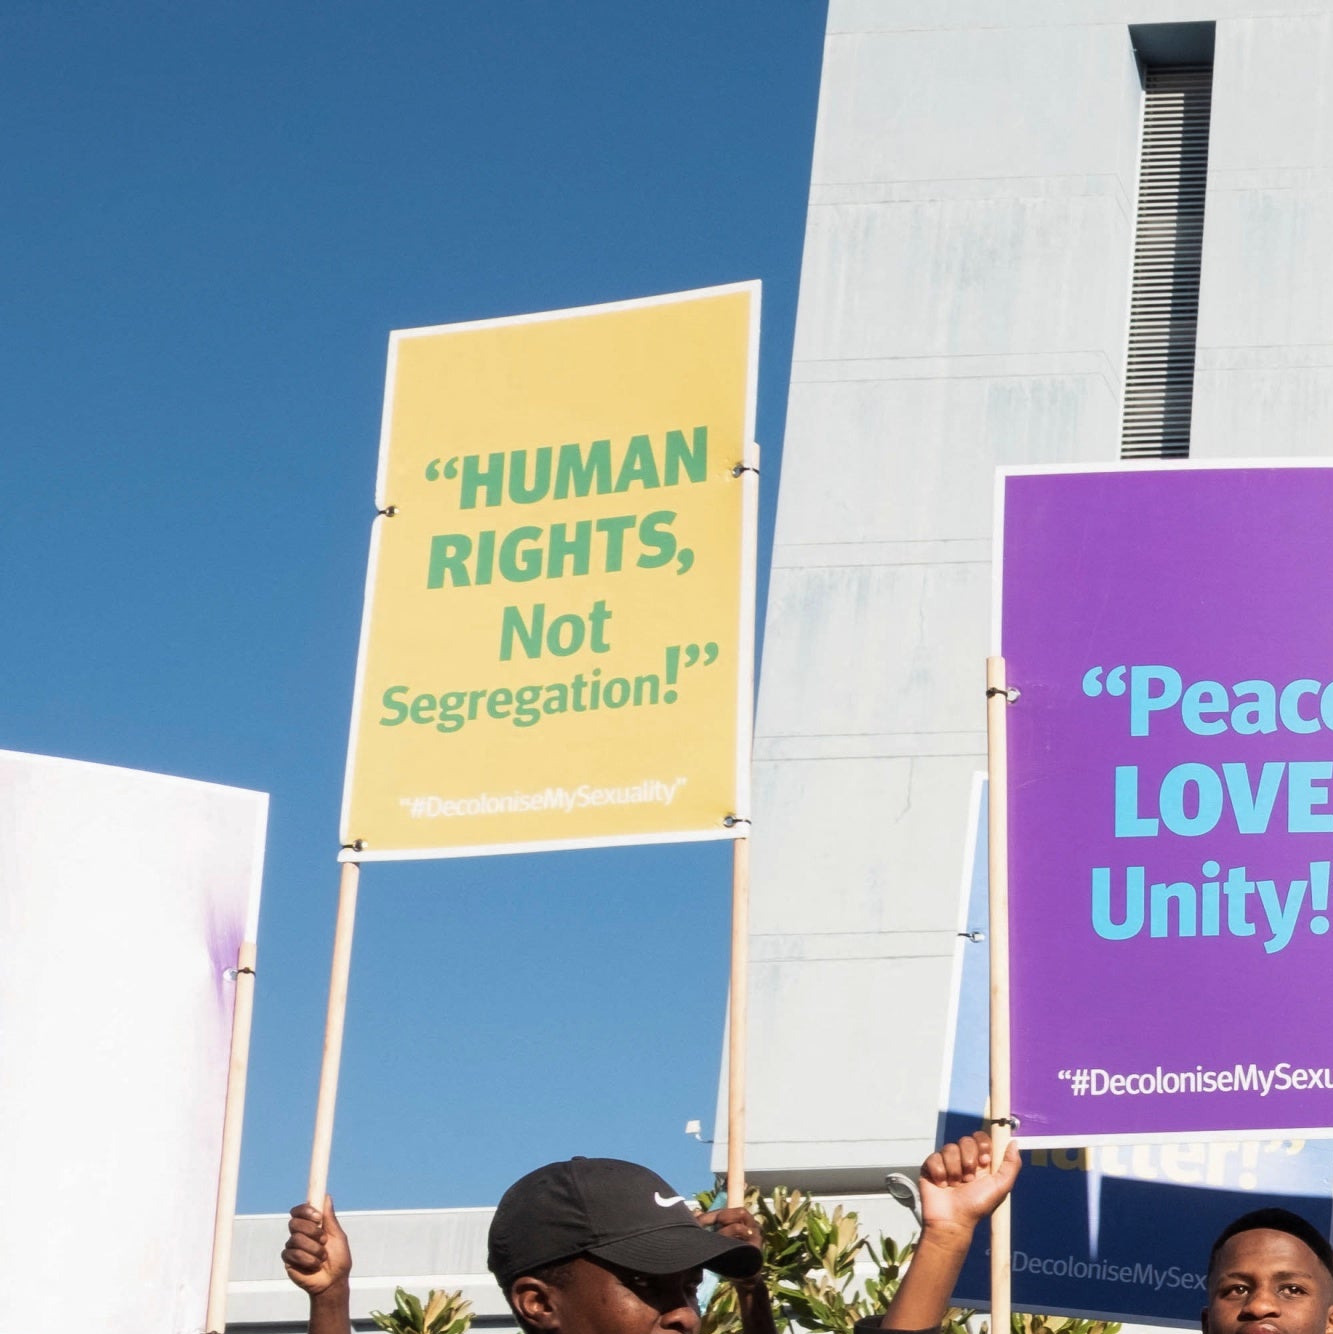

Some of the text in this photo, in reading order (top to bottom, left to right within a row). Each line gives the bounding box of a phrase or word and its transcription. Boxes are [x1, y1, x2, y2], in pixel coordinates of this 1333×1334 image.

[425, 426, 708, 510] “HUMAN
[427, 510, 694, 589] RIGHTS,
[500, 600, 612, 661] Not
[380, 642, 720, 733] Segregation!”
[399, 778, 687, 818] “#DecoloniseMySexuality”
